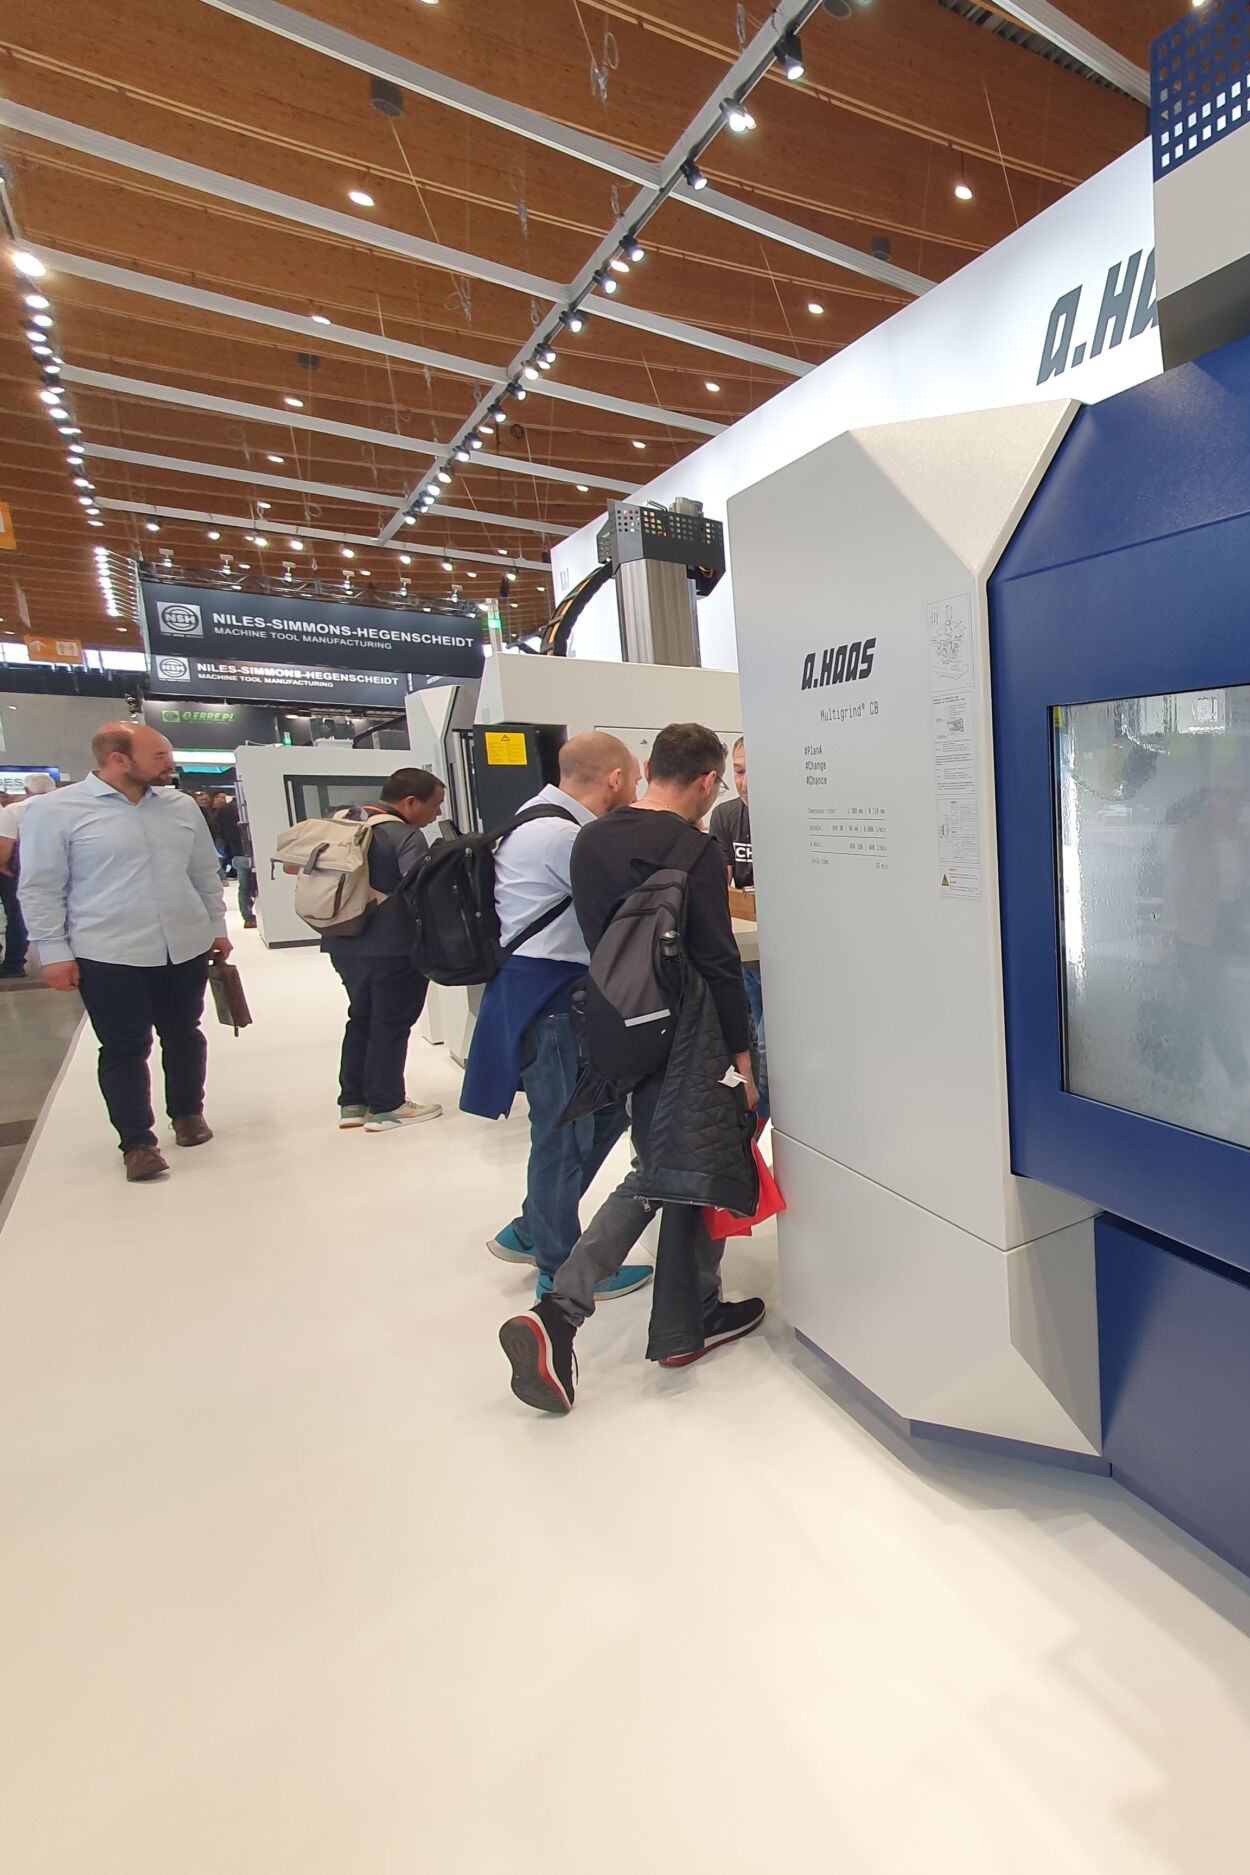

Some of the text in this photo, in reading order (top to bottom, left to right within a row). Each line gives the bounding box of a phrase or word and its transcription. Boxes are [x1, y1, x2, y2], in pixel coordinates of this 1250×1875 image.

[213, 613, 474, 648] NILES-SIMMONS-HEGENSCHEIDT
[214, 627, 267, 639] MACHINE
[270, 632, 300, 642] TOOL
[302, 635, 392, 650] MANUFACTURING
[197, 663, 399, 686] NILES-SIMMONS-HEGENSCHEIDT
[198, 673, 237, 681] MACHINE
[264, 678, 334, 688] MANUFACTURING
